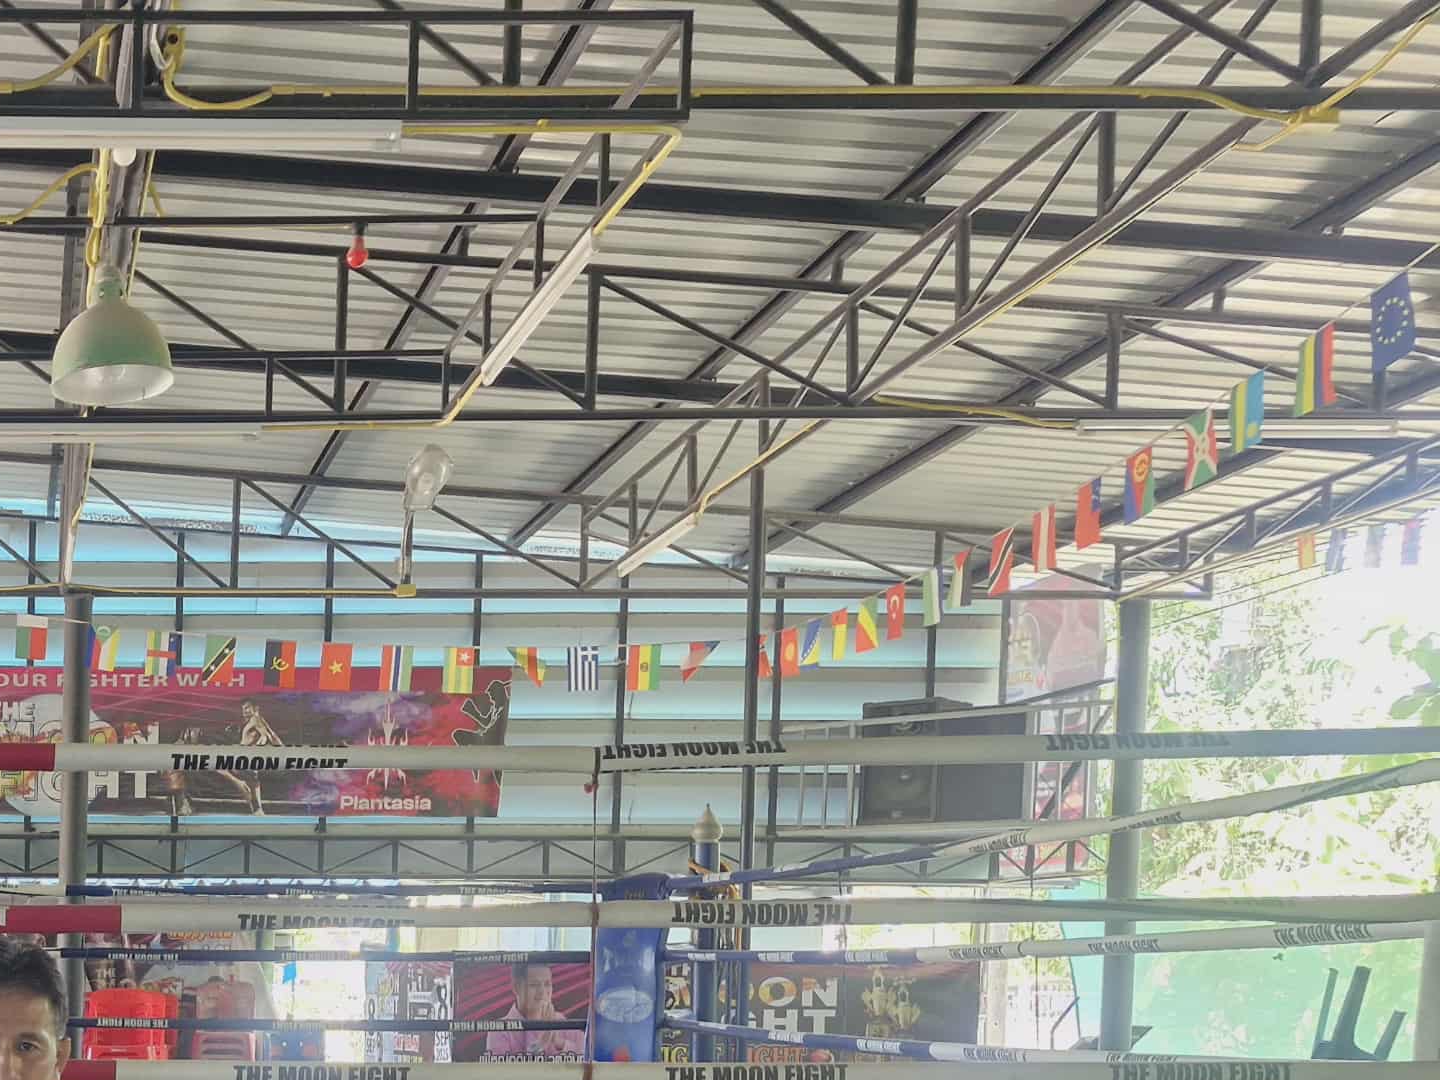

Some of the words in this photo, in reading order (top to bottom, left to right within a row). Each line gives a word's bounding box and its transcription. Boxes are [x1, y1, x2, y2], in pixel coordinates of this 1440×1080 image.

[57, 674, 168, 688] FHTER
[176, 673, 245, 688] WH
[171, 754, 210, 770] THE
[215, 756, 280, 770] MOON
[340, 795, 431, 810] Plantasia
[237, 914, 277, 930] THE
[672, 903, 735, 924] FIGHT
[742, 903, 807, 925] MOON
[813, 903, 852, 926] THE
[1273, 927, 1299, 946] THE
[1297, 925, 1332, 944] MOON
[1334, 923, 1371, 941] FIGHT
